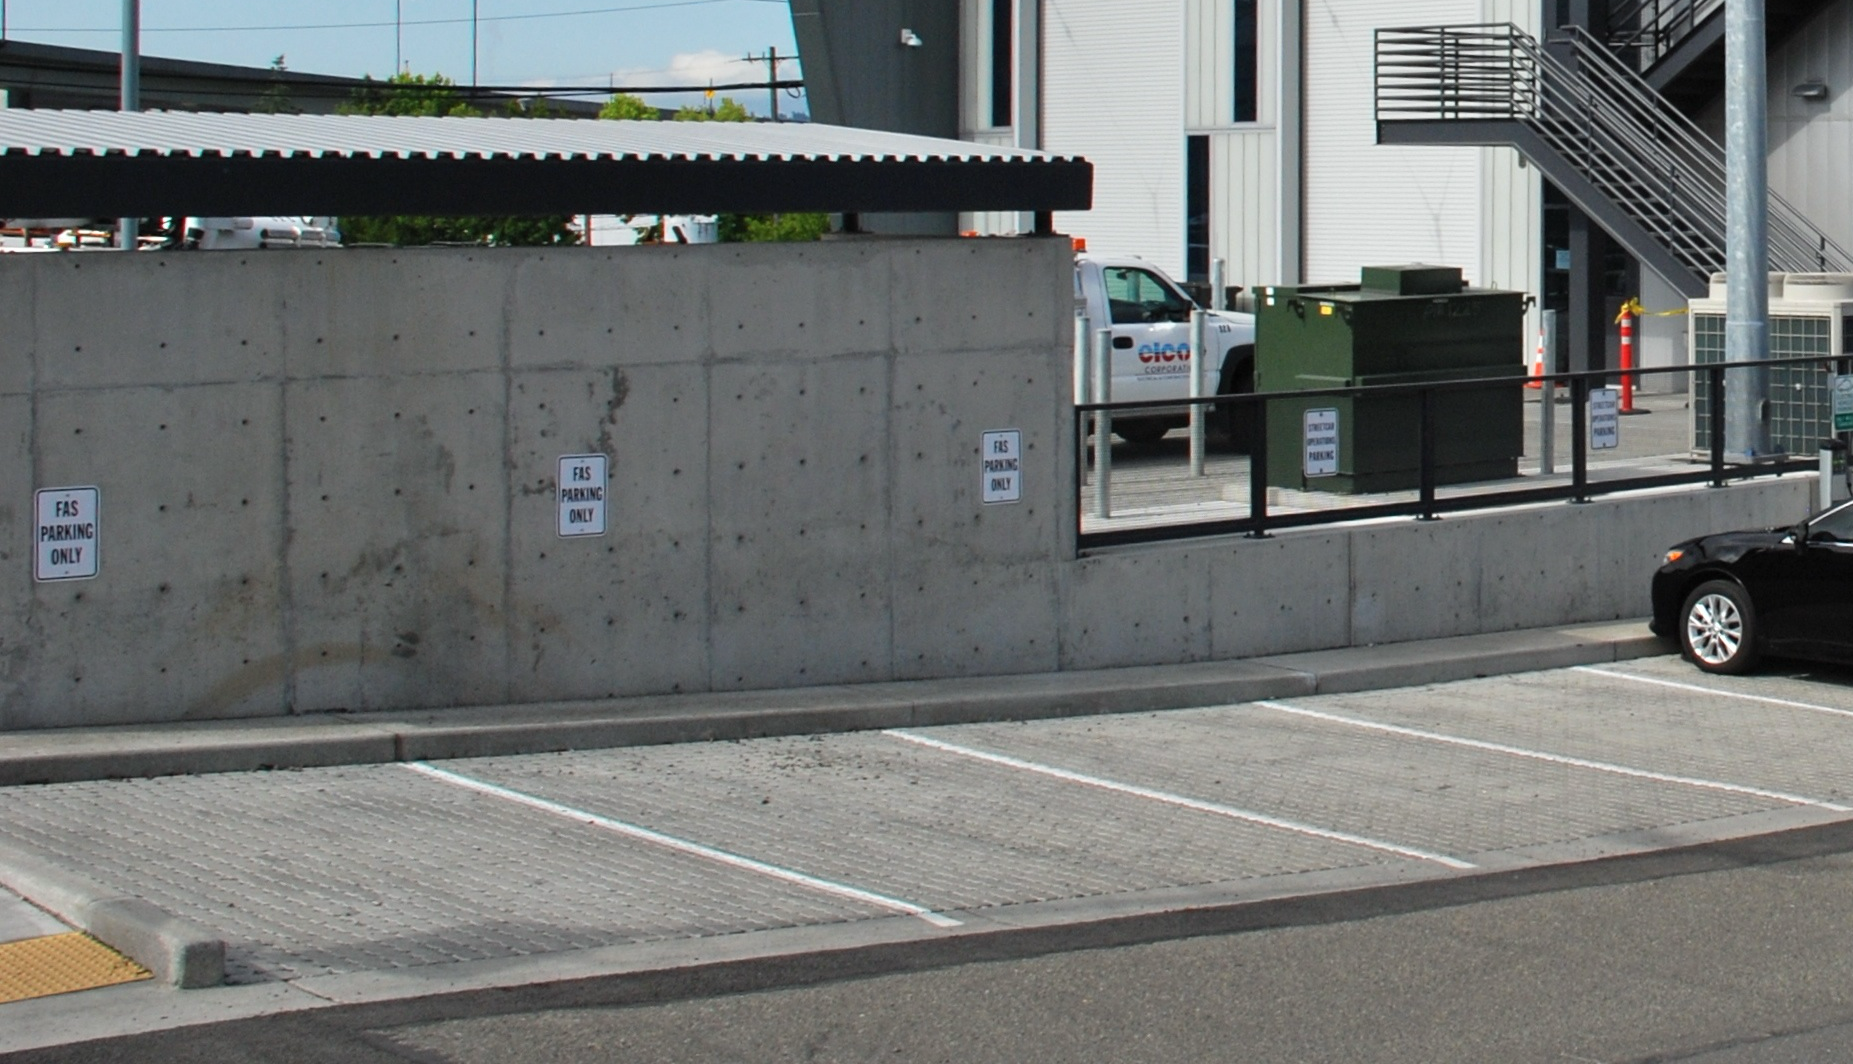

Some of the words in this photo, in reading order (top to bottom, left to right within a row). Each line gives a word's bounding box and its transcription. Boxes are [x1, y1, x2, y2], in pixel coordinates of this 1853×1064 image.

[1594, 426, 1615, 436] PARKING
[994, 440, 1009, 454] FAS
[1309, 450, 1334, 461] PARKING
[985, 458, 1018, 473] PARKING
[573, 466, 591, 482] FAS
[991, 477, 1011, 492] ONLY
[561, 486, 604, 503] PARKING
[56, 500, 79, 517] FAS
[569, 508, 594, 524] ONLY
[41, 522, 93, 542] PARKING
[51, 547, 82, 566] ONLY
